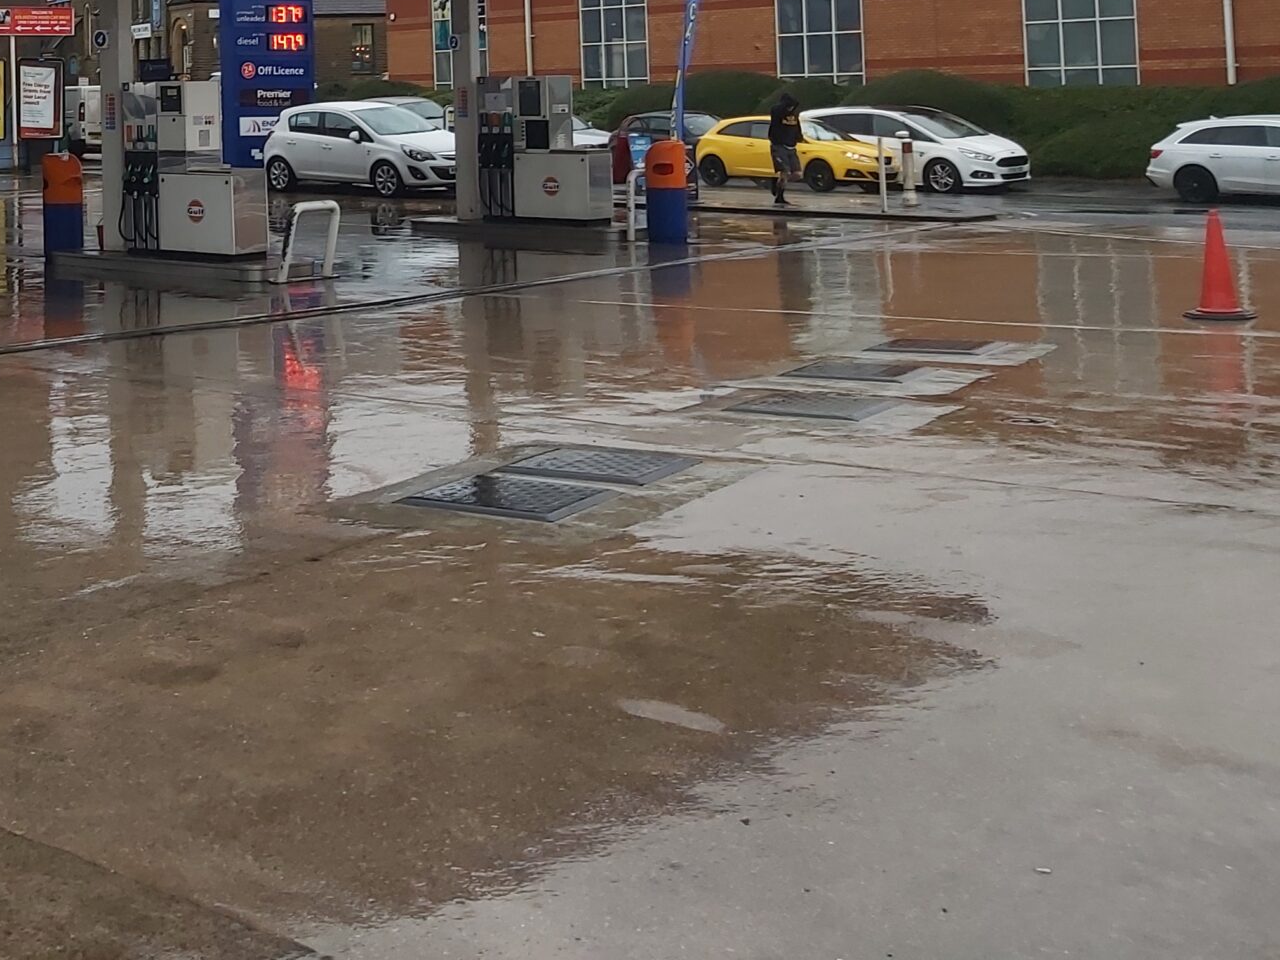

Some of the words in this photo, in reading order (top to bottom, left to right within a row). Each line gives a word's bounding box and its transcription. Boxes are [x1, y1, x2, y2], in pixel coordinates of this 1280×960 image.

[236, 15, 266, 23] unleaded
[236, 36, 259, 46] diesel
[257, 66, 272, 76] Off
[273, 66, 305, 76] Licence
[257, 89, 292, 99] Premier
[257, 99, 272, 107] food
[279, 99, 291, 107] fuel
[187, 207, 205, 215] Gulf
